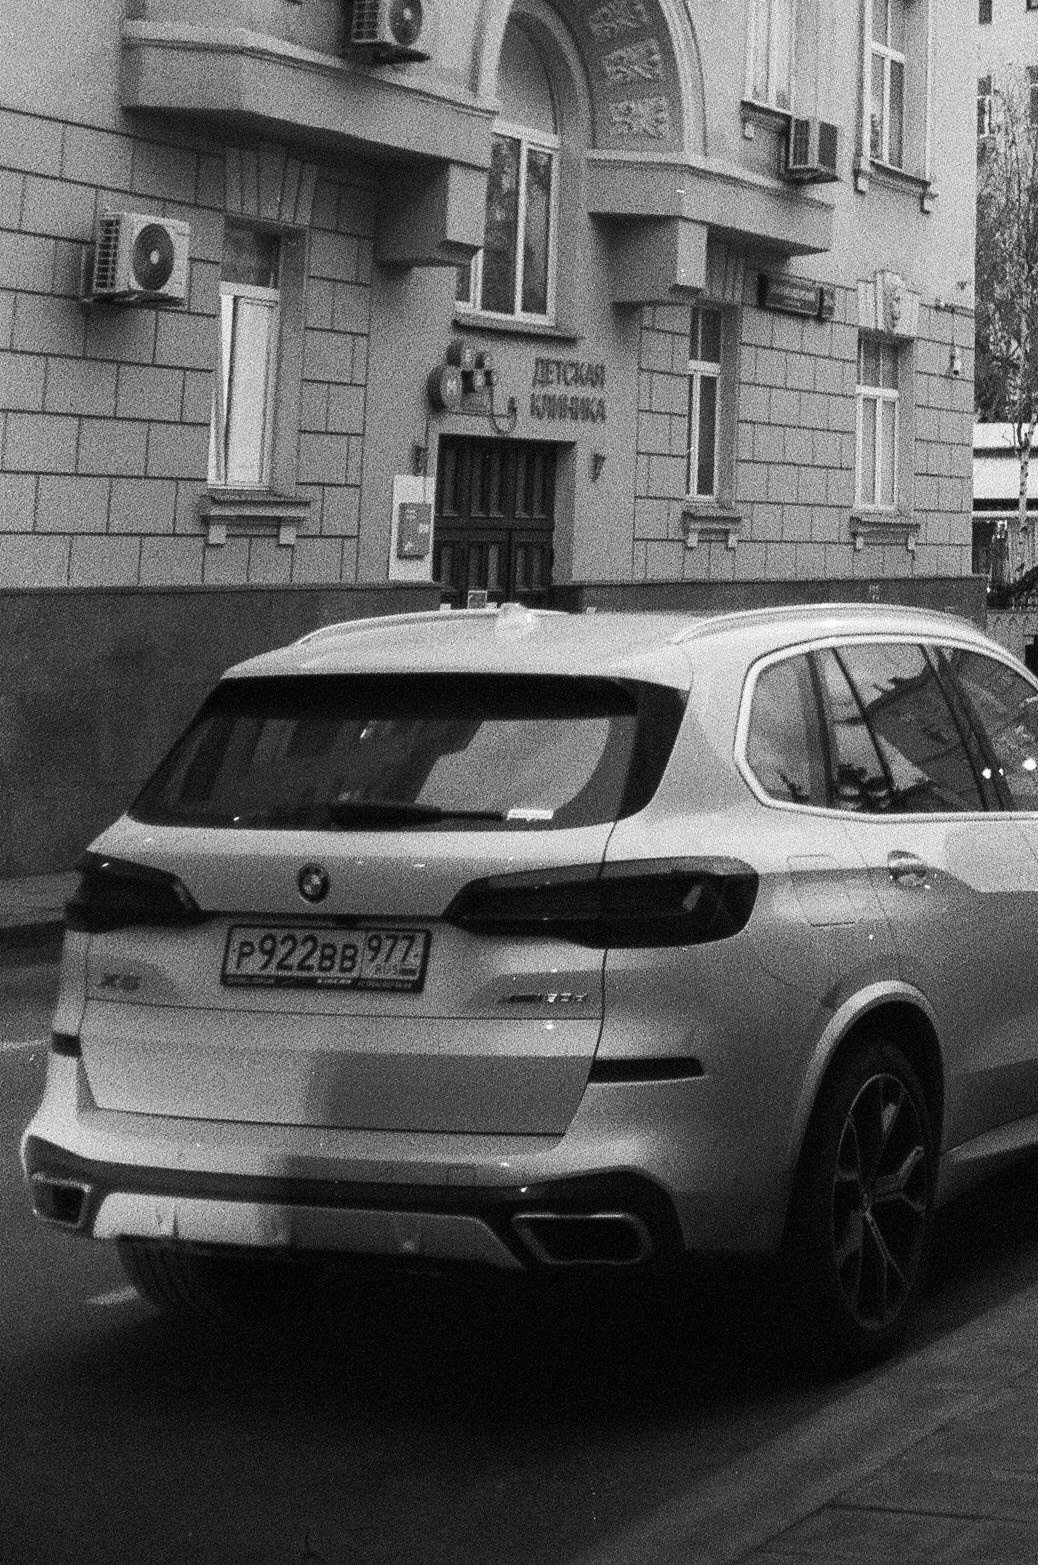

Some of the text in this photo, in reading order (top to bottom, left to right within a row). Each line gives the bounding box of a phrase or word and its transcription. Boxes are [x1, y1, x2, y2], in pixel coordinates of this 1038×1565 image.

[531, 357, 606, 388] ДЕТСКАЯ
[530, 392, 606, 423] КЛИНИКА
[366, 934, 416, 963] 977
